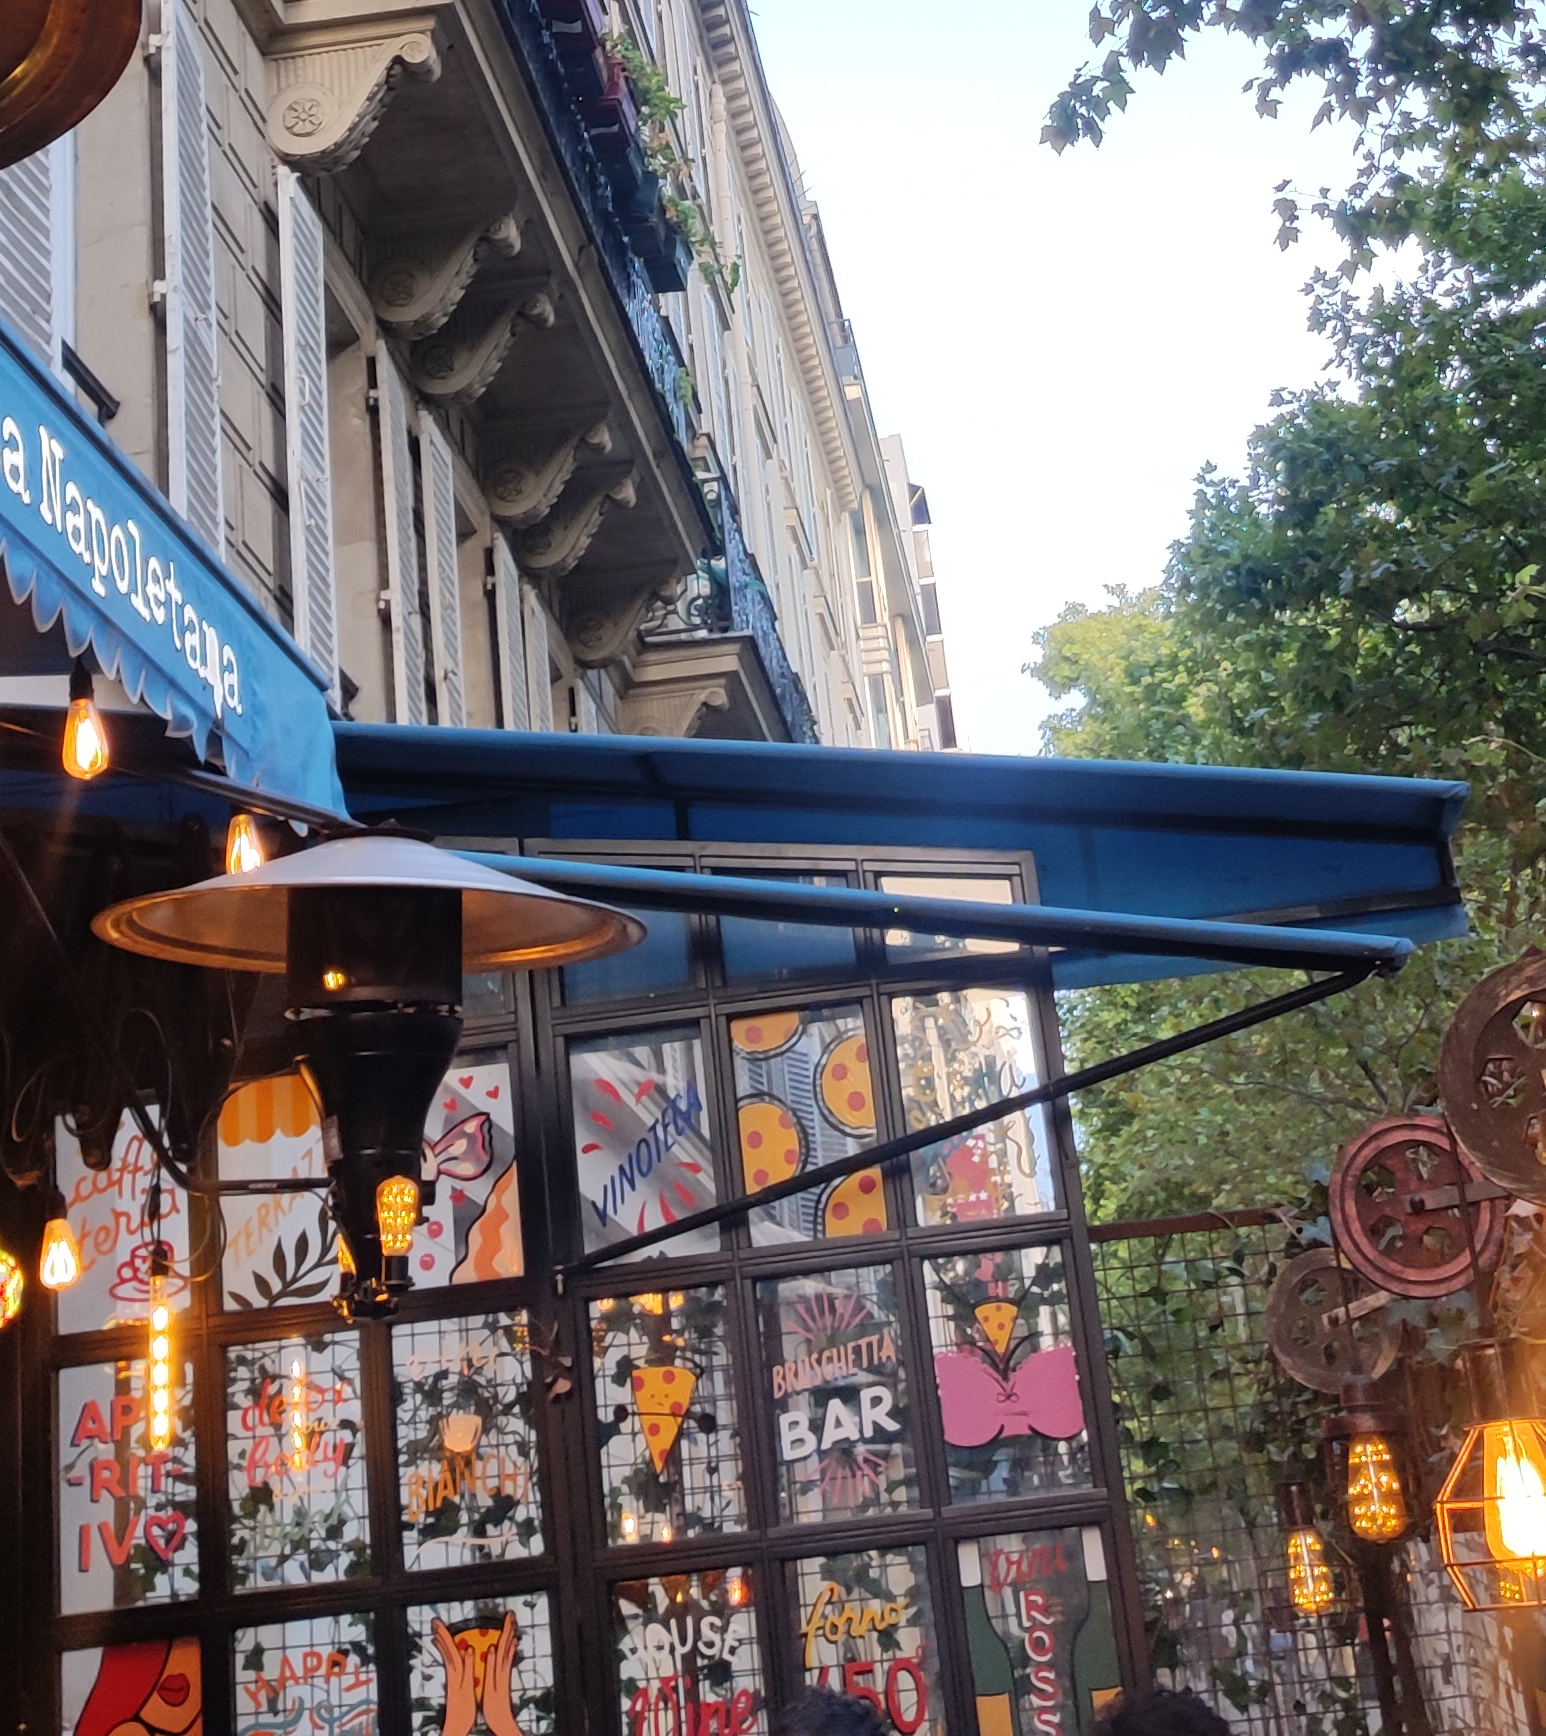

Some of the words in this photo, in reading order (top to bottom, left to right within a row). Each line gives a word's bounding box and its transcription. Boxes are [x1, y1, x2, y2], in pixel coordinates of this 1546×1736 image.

[39, 425, 243, 719] Napoletana
[591, 1079, 703, 1228] VINOTECA
[772, 1329, 897, 1400] BRUSCHETTA
[779, 1385, 902, 1462] BAR
[408, 1452, 530, 1525] BIANCHI
[799, 1581, 911, 1669] forno
